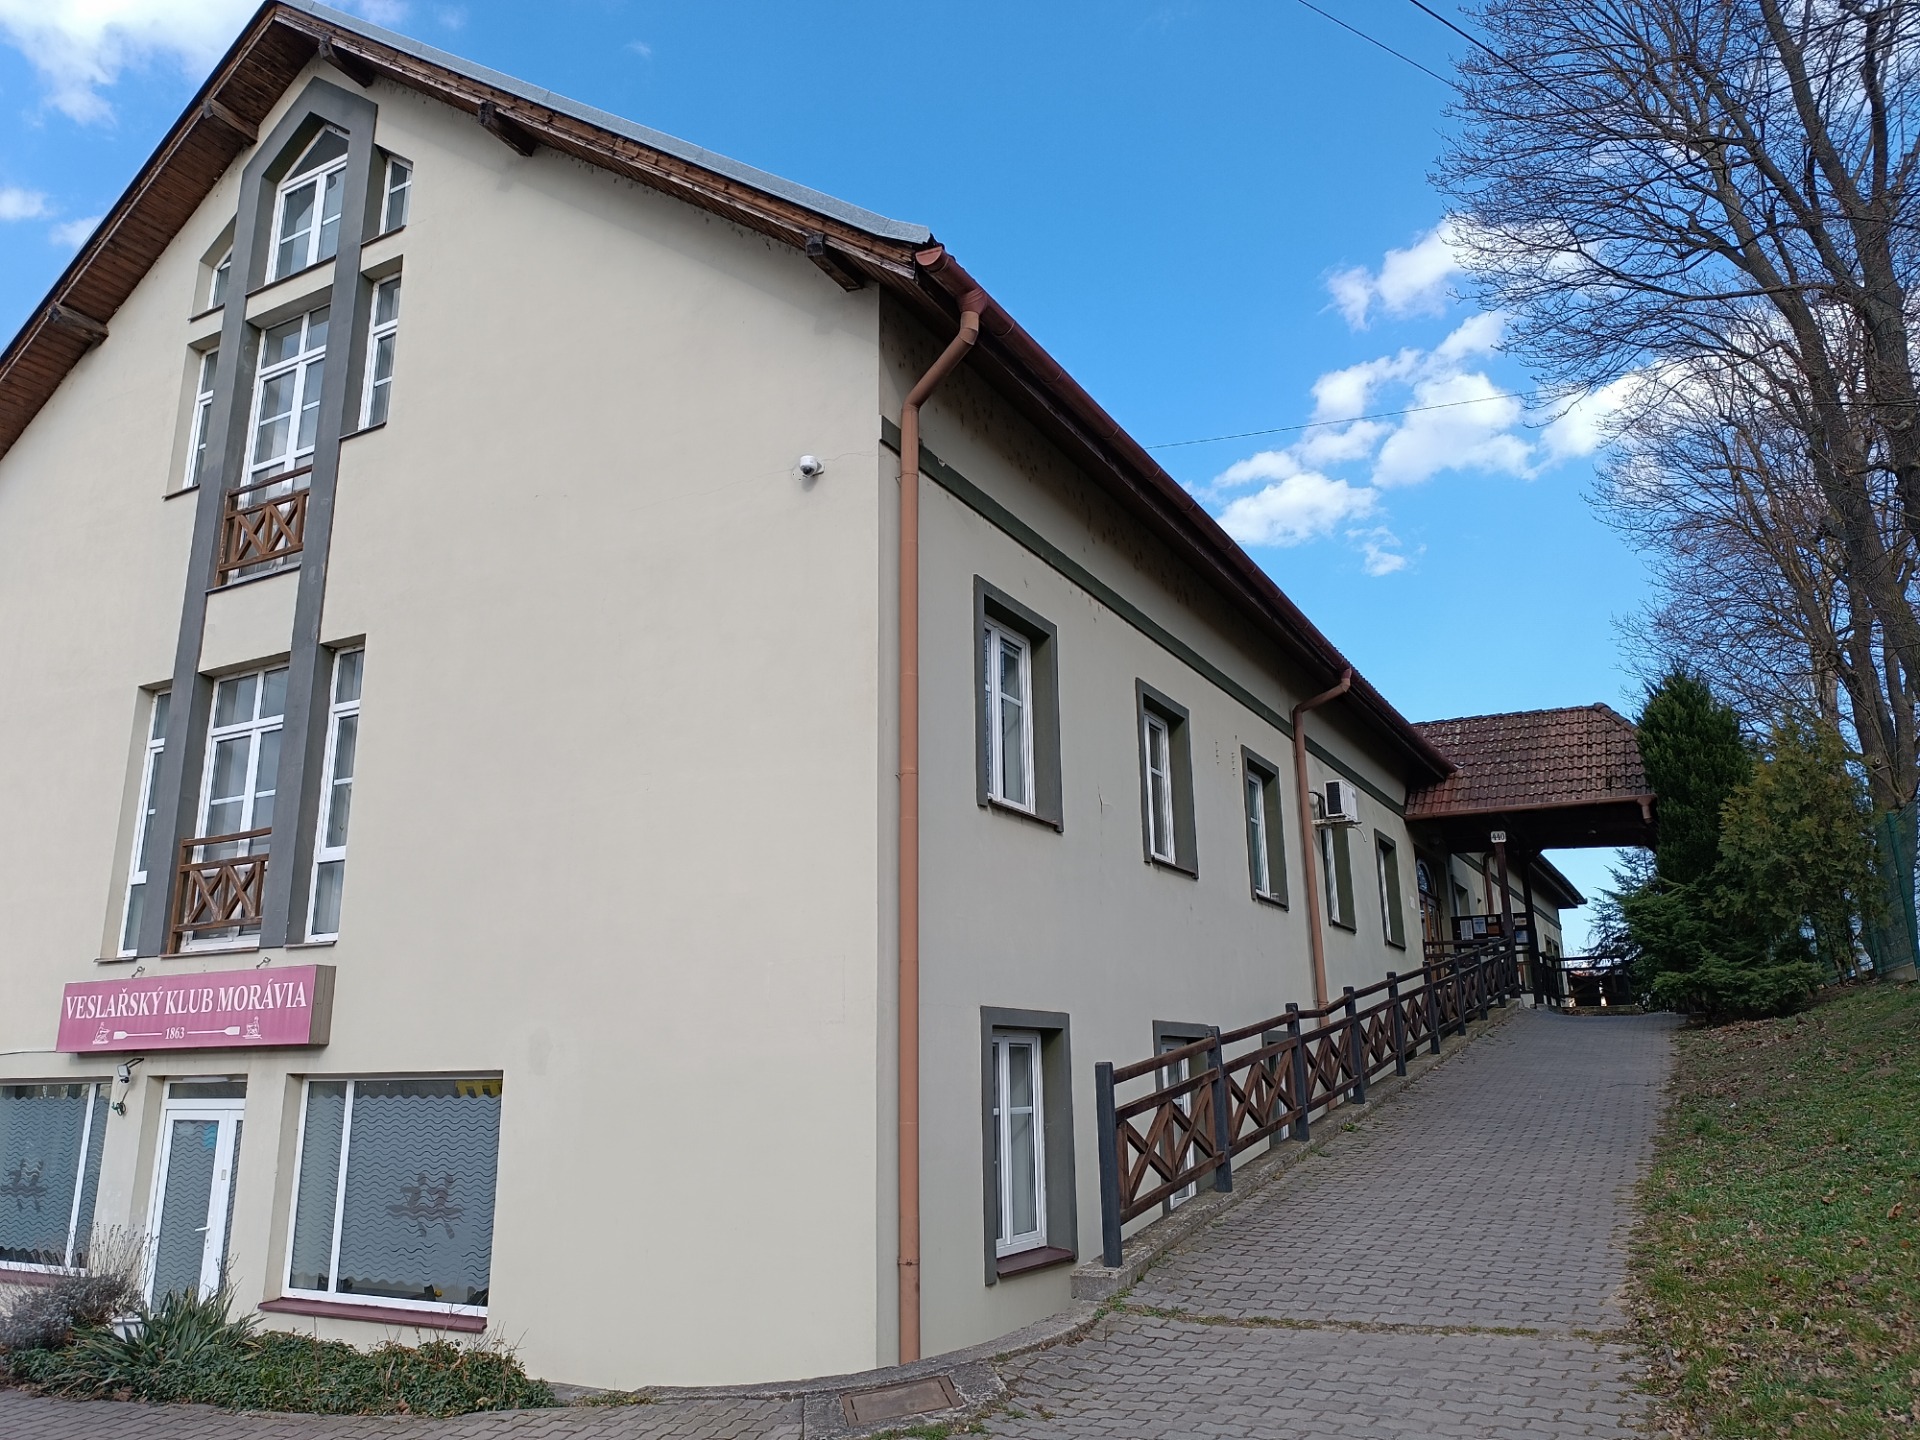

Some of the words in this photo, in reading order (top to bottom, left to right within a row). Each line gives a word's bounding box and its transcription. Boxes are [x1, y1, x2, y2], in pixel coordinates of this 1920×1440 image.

[66, 986, 164, 1019] VESLAŘSKÝ
[164, 988, 214, 1015] KLUB
[216, 978, 307, 1012] MORÁVIA
[165, 1027, 185, 1040] 1863
